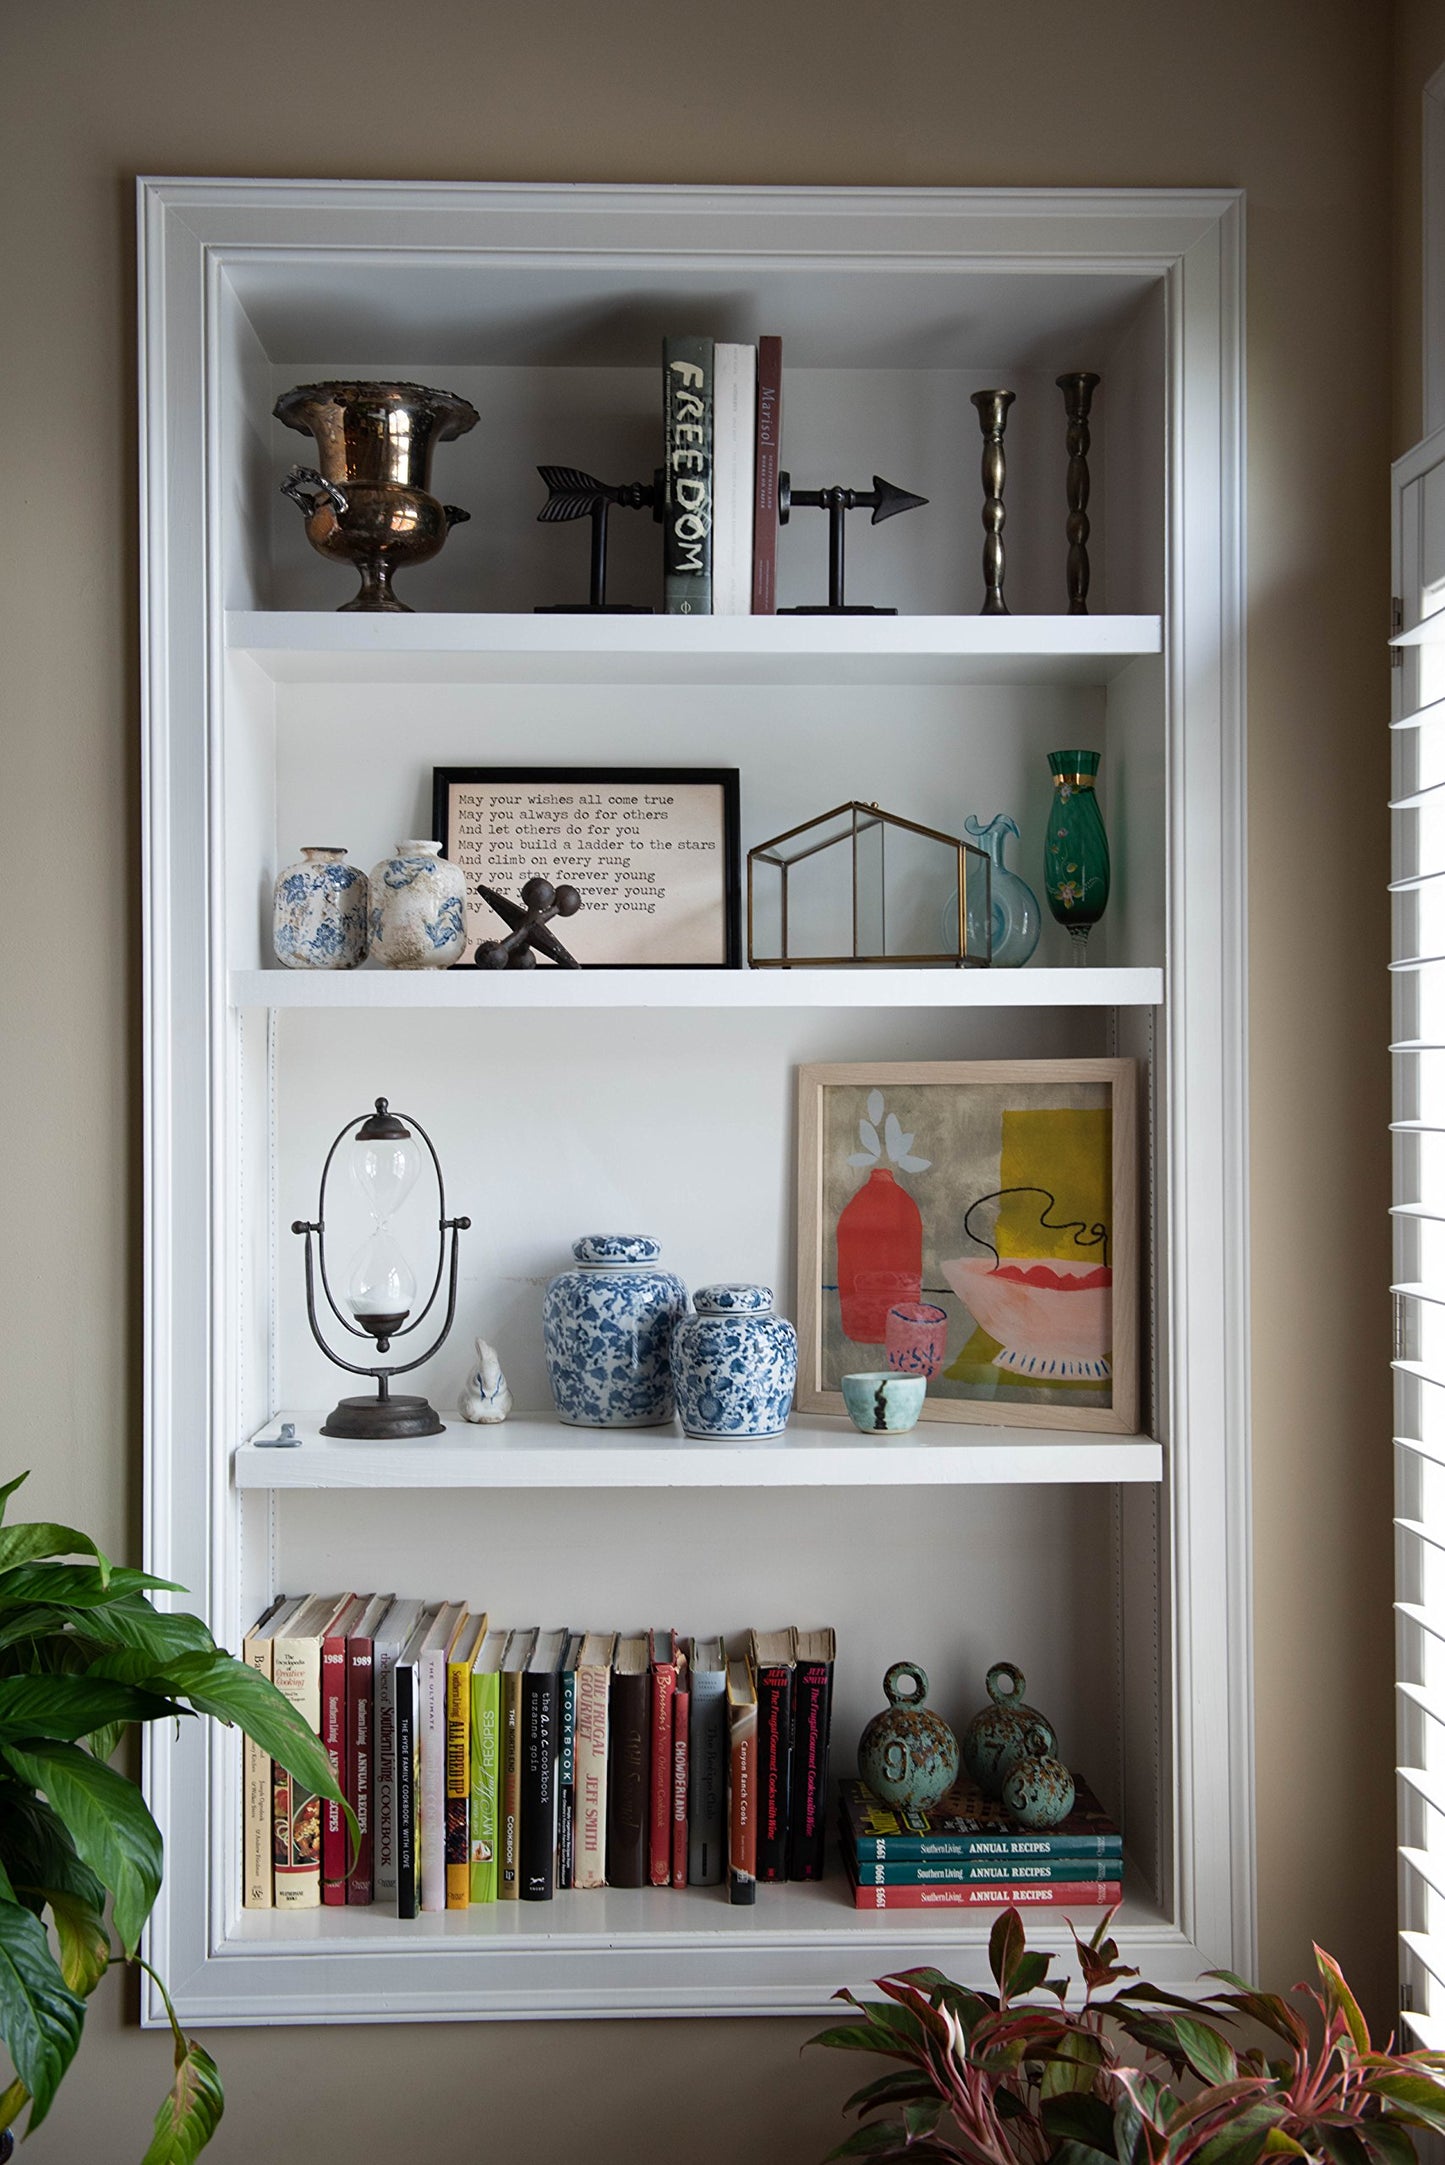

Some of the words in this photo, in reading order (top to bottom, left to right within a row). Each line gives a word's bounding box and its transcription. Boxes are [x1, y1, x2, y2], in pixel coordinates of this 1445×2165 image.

[761, 387, 776, 447] Marisol
[669, 361, 706, 571] FREEDOM
[459, 794, 484, 806] May
[490, 796, 522, 806] your
[528, 794, 573, 805] wishes
[579, 794, 602, 805] all
[608, 796, 638, 805] come
[644, 795, 674, 805] true
[459, 810, 484, 822] May
[490, 811, 514, 822] you
[520, 809, 568, 822] always
[574, 809, 589, 820] do
[595, 809, 618, 820] for
[623, 809, 668, 820] others
[459, 824, 482, 835] And
[489, 824, 509, 835] let
[515, 824, 561, 835] others
[567, 824, 582, 835] do
[587, 824, 610, 835] for
[616, 827, 640, 837] you
[459, 839, 483, 852] May
[489, 841, 514, 852] you
[520, 838, 557, 850] build
[563, 841, 571, 850] a
[578, 838, 625, 850] ladder
[630, 840, 644, 850] to
[650, 838, 672, 850] the
[677, 840, 716, 850] stars
[459, 854, 482, 865] And
[488, 854, 525, 865] climb
[531, 856, 547, 865] on
[553, 856, 592, 868] every
[598, 856, 631, 868] rung
[489, 871, 513, 882] you
[556, 870, 609, 880] forever
[614, 872, 656, 883] young
[624, 887, 666, 898] young
[614, 903, 656, 913] young
[323, 1654, 344, 1664] 1988
[352, 1656, 372, 1666] 1989
[380, 1653, 391, 1668] the
[276, 1678, 305, 1687] Cooking
[380, 1670, 390, 1690] best
[450, 1670, 462, 1700] Southern
[594, 1671, 607, 1697] THE
[381, 1692, 391, 1704] of
[542, 1692, 551, 1711] the
[580, 1671, 594, 1742] GOURMET
[657, 1675, 672, 1730] Brennan's
[770, 1690, 780, 1705] The
[810, 1688, 819, 1702] The
[328, 1696, 340, 1725] Southern
[358, 1698, 368, 1726] Southern
[450, 1700, 462, 1718] Living
[508, 1708, 516, 1726] THE
[530, 1692, 539, 1738] suzanne
[768, 1706, 779, 1734] Frugal
[808, 1703, 818, 1731] Frugal
[327, 1726, 340, 1743] Living
[356, 1726, 368, 1745] Living
[380, 1706, 394, 1752] Southern
[448, 1720, 464, 1742] ALL
[482, 1710, 494, 1766] RECIPES
[508, 1728, 516, 1754] NORTH
[563, 1689, 572, 1780] COOKBOOK
[592, 1702, 606, 1758] FRUGAL
[707, 1726, 718, 1749] The
[448, 1743, 464, 1777] FIRED
[529, 1744, 540, 1771] goin
[740, 1740, 748, 1770] Canyon
[770, 1734, 778, 1770] Gourmet
[808, 1731, 818, 1768] Gourmet
[884, 1741, 908, 1783] 9
[358, 1752, 368, 1792] ANNUAL
[377, 1752, 396, 1783] Living
[540, 1750, 550, 1803] cookbook
[658, 1756, 666, 1786] Orleans
[702, 1751, 717, 1791] Recipe
[448, 1778, 464, 1794] UP
[586, 1773, 598, 1805] JEFF
[675, 1741, 686, 1822] CHOWDERLAND
[740, 1772, 748, 1798] Ranch
[769, 1772, 778, 1798] Cooks
[807, 1770, 816, 1796] Cooks
[1010, 1776, 1029, 1811] 3
[329, 1800, 338, 1832] ECIPES
[358, 1794, 368, 1834] RECIPES
[402, 1784, 410, 1827] COOKBOOK:
[657, 1789, 666, 1828] Cookbook
[706, 1792, 718, 1820] Club
[740, 1800, 748, 1826] Cooks
[768, 1800, 777, 1818] with
[807, 1796, 816, 1816] with
[380, 1784, 391, 1866] COOKBOOK
[482, 1816, 493, 1834] MY
[586, 1808, 598, 1851] SMITH
[768, 1820, 776, 1840] Wine
[806, 1816, 816, 1837] Wine
[402, 1828, 410, 1849] WITH
[876, 1838, 886, 1860] 1992
[920, 1844, 945, 1854] Southern
[946, 1844, 962, 1854] Living
[969, 1843, 1008, 1854] ANNUAL
[1010, 1842, 1051, 1853] RECIPES
[402, 1850, 410, 1868] LOVE
[875, 1864, 885, 1885] 1990
[917, 1868, 944, 1879] Southern
[944, 1868, 963, 1880] Living
[970, 1867, 1010, 1878] ANNUAL
[1011, 1866, 1052, 1878] RECIPES
[876, 1887, 886, 1908] 1993
[921, 1892, 945, 1902] Southern
[946, 1892, 962, 1904] Living
[970, 1891, 1010, 1902] ANNUAL
[1012, 1890, 1052, 1900] RECIPES
